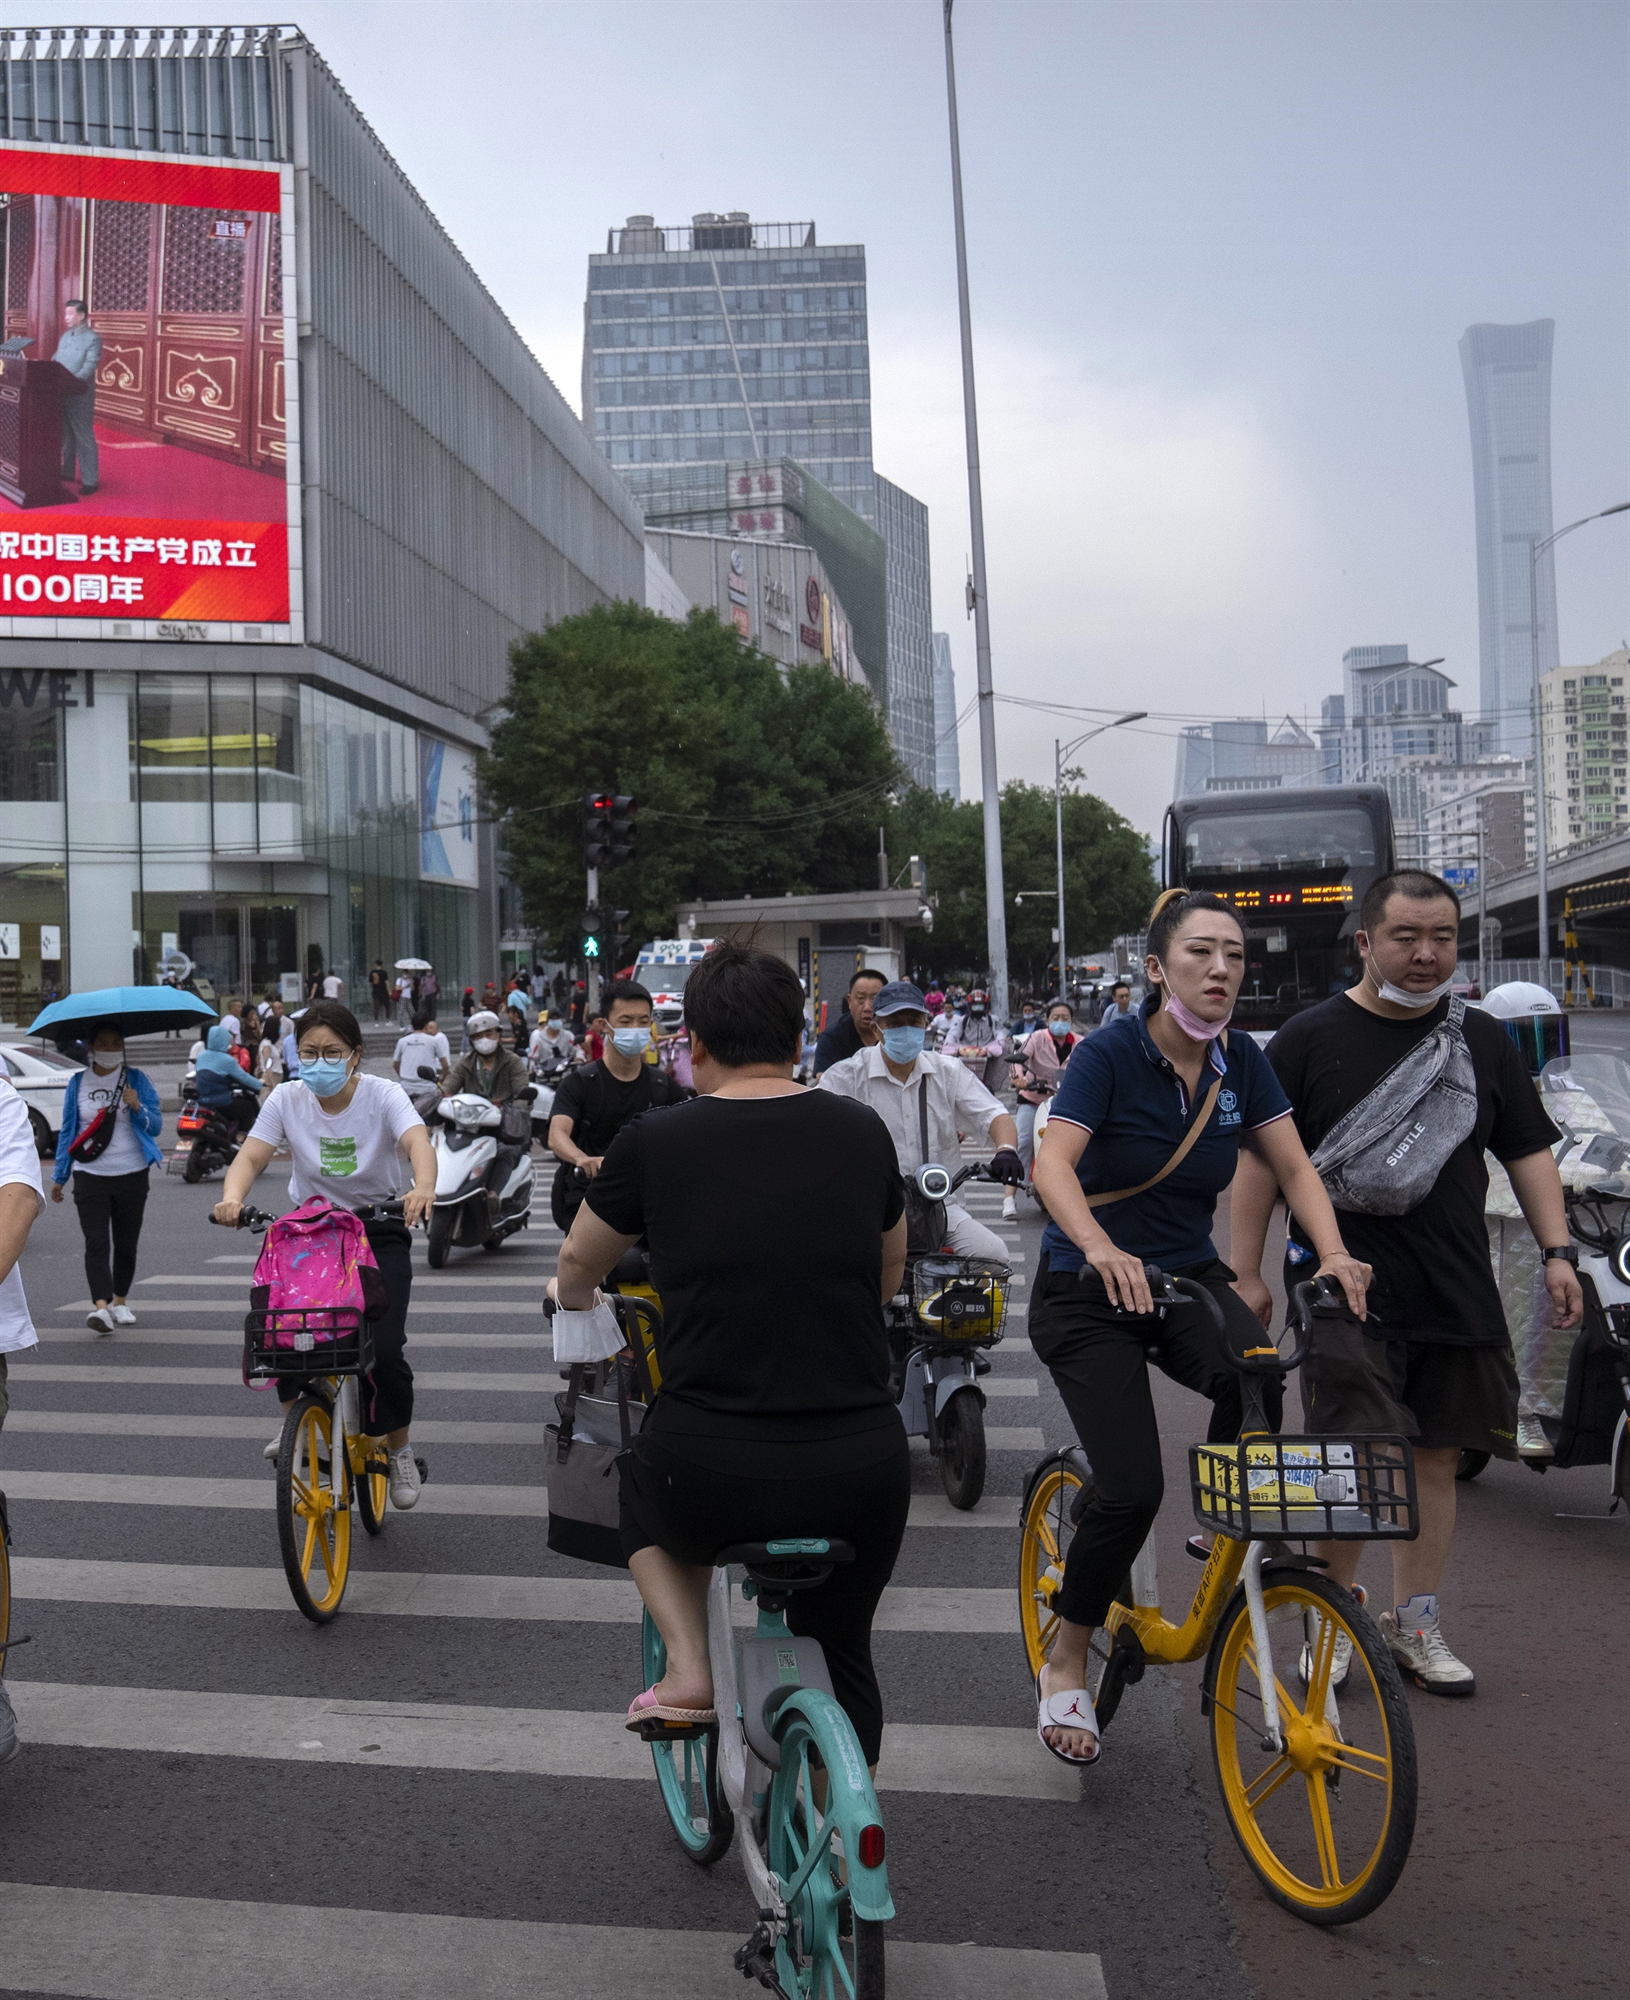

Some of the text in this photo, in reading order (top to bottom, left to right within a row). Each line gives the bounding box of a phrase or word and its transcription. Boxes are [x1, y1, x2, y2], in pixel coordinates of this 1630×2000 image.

[215, 220, 247, 238] 直播
[3, 573, 144, 604] 100周年
[1386, 1122, 1426, 1167] SUBTLE
